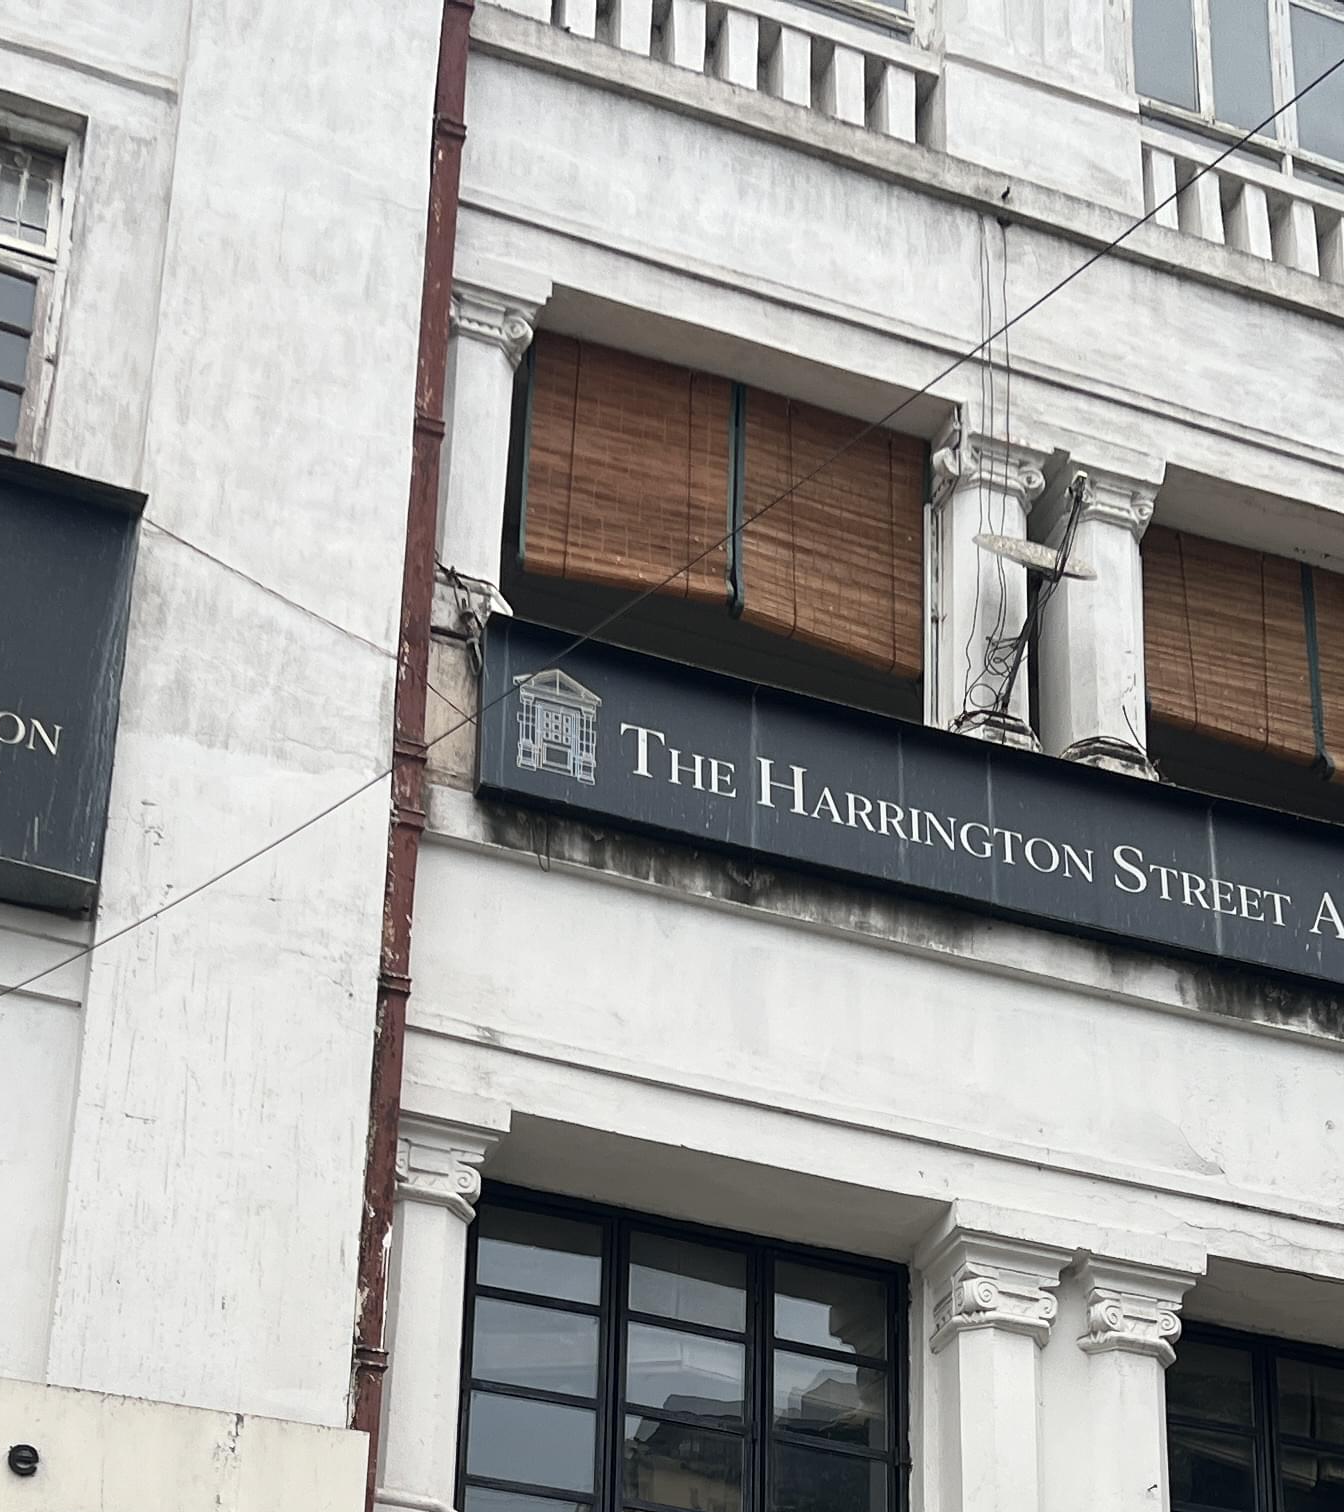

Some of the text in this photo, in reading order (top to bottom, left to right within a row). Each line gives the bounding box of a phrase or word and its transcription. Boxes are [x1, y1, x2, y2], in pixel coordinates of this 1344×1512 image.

[619, 722, 737, 798] THE
[756, 756, 1095, 884] HARRINGTON
[1112, 844, 1292, 928] STREET
